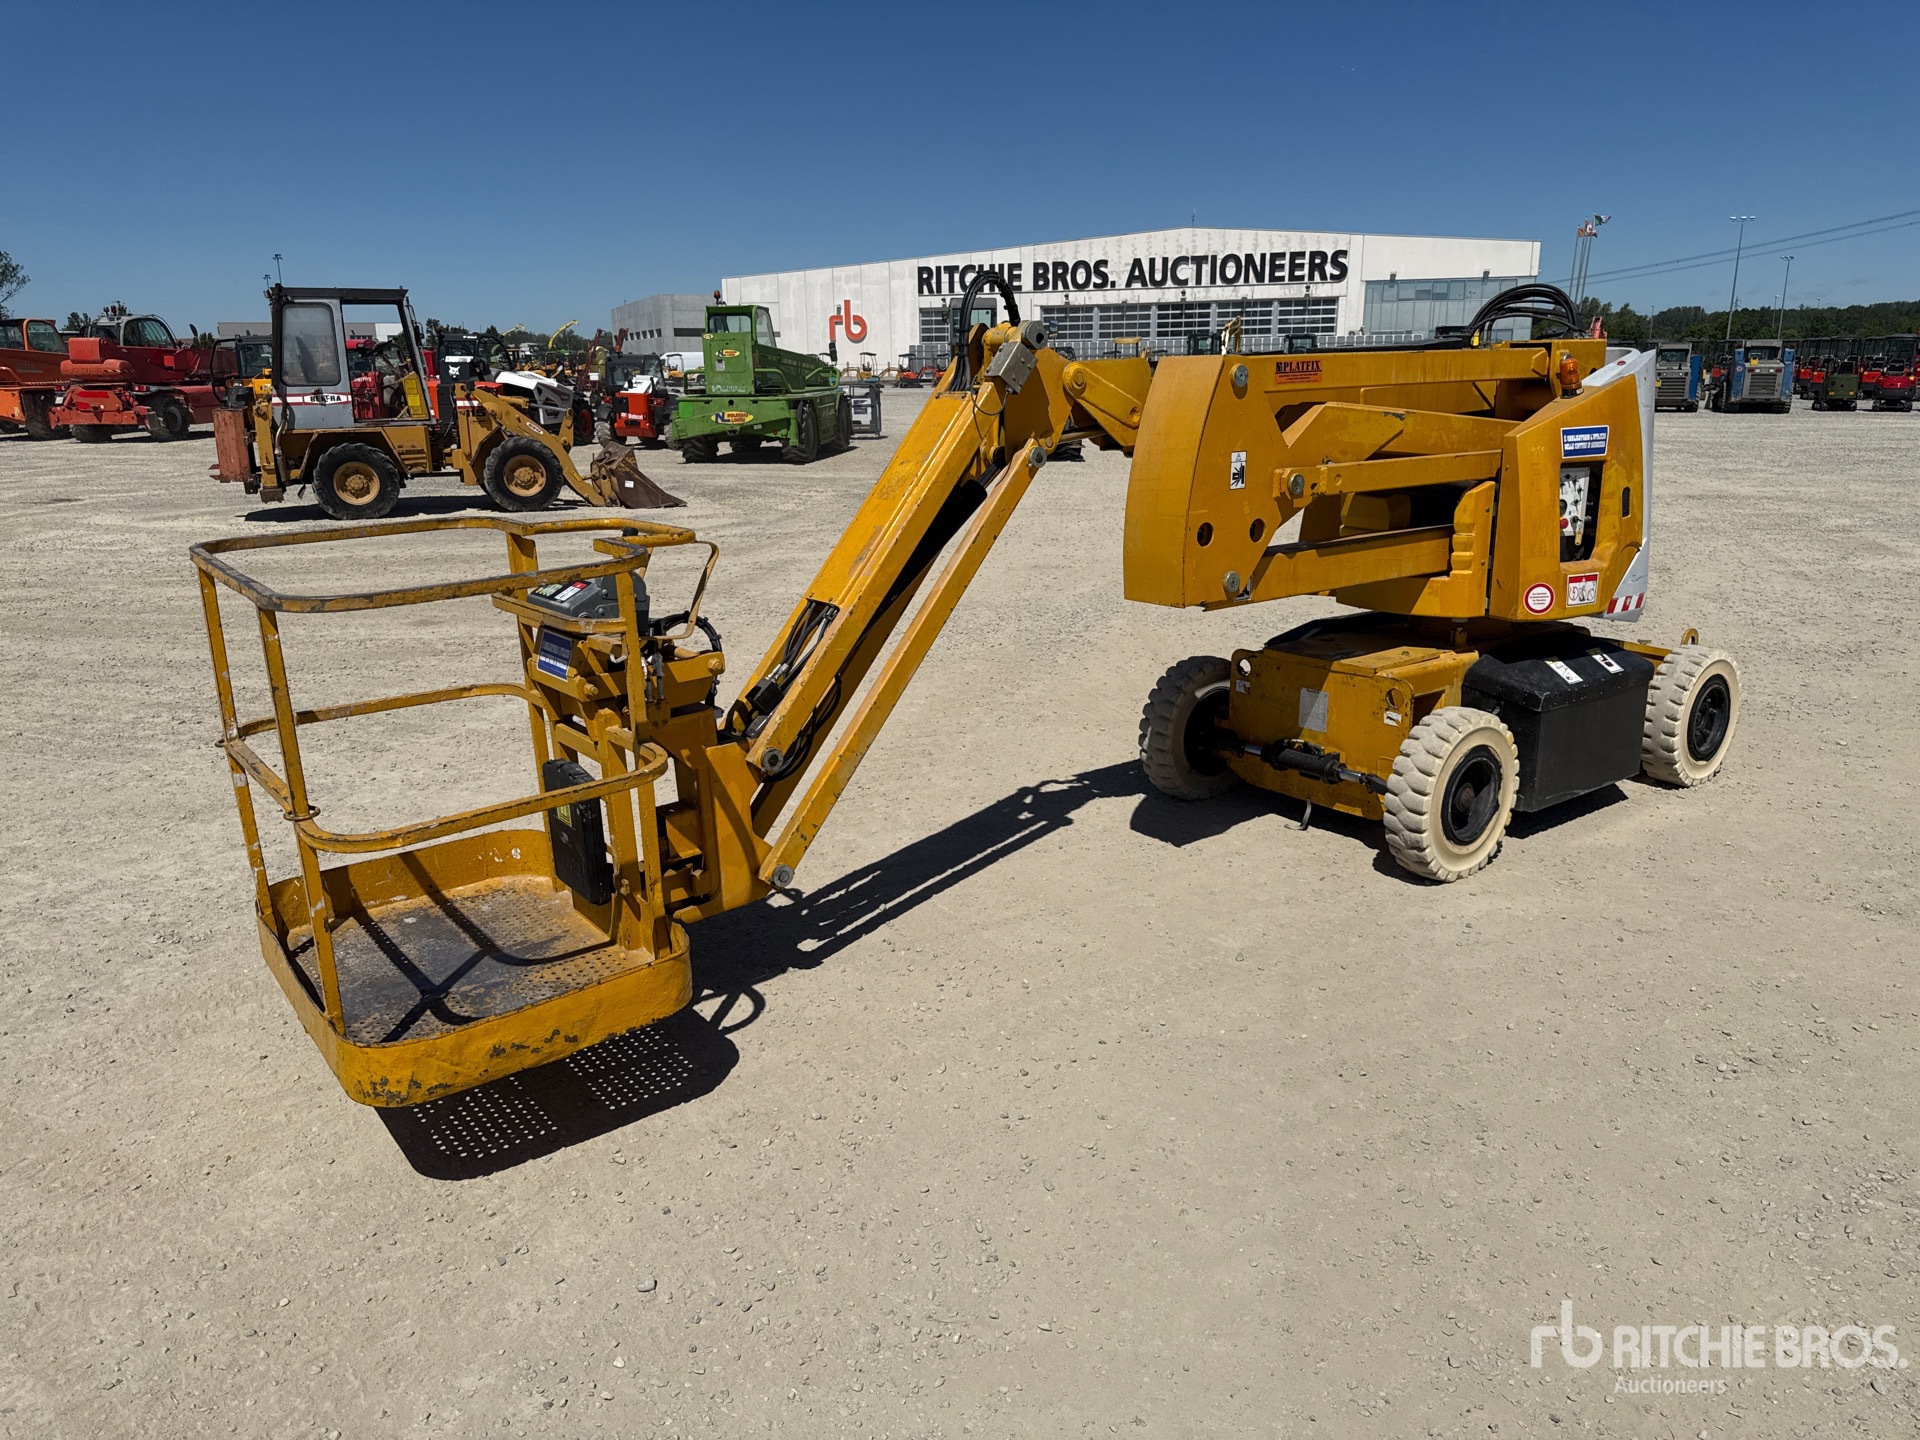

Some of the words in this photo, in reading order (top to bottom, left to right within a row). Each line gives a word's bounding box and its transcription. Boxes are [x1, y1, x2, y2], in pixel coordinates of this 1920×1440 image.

[918, 263, 1022, 294] RITCHIE
[1033, 259, 1116, 290] BROS.
[1125, 249, 1348, 288] AUCTIONEERS
[829, 299, 867, 343] rb
